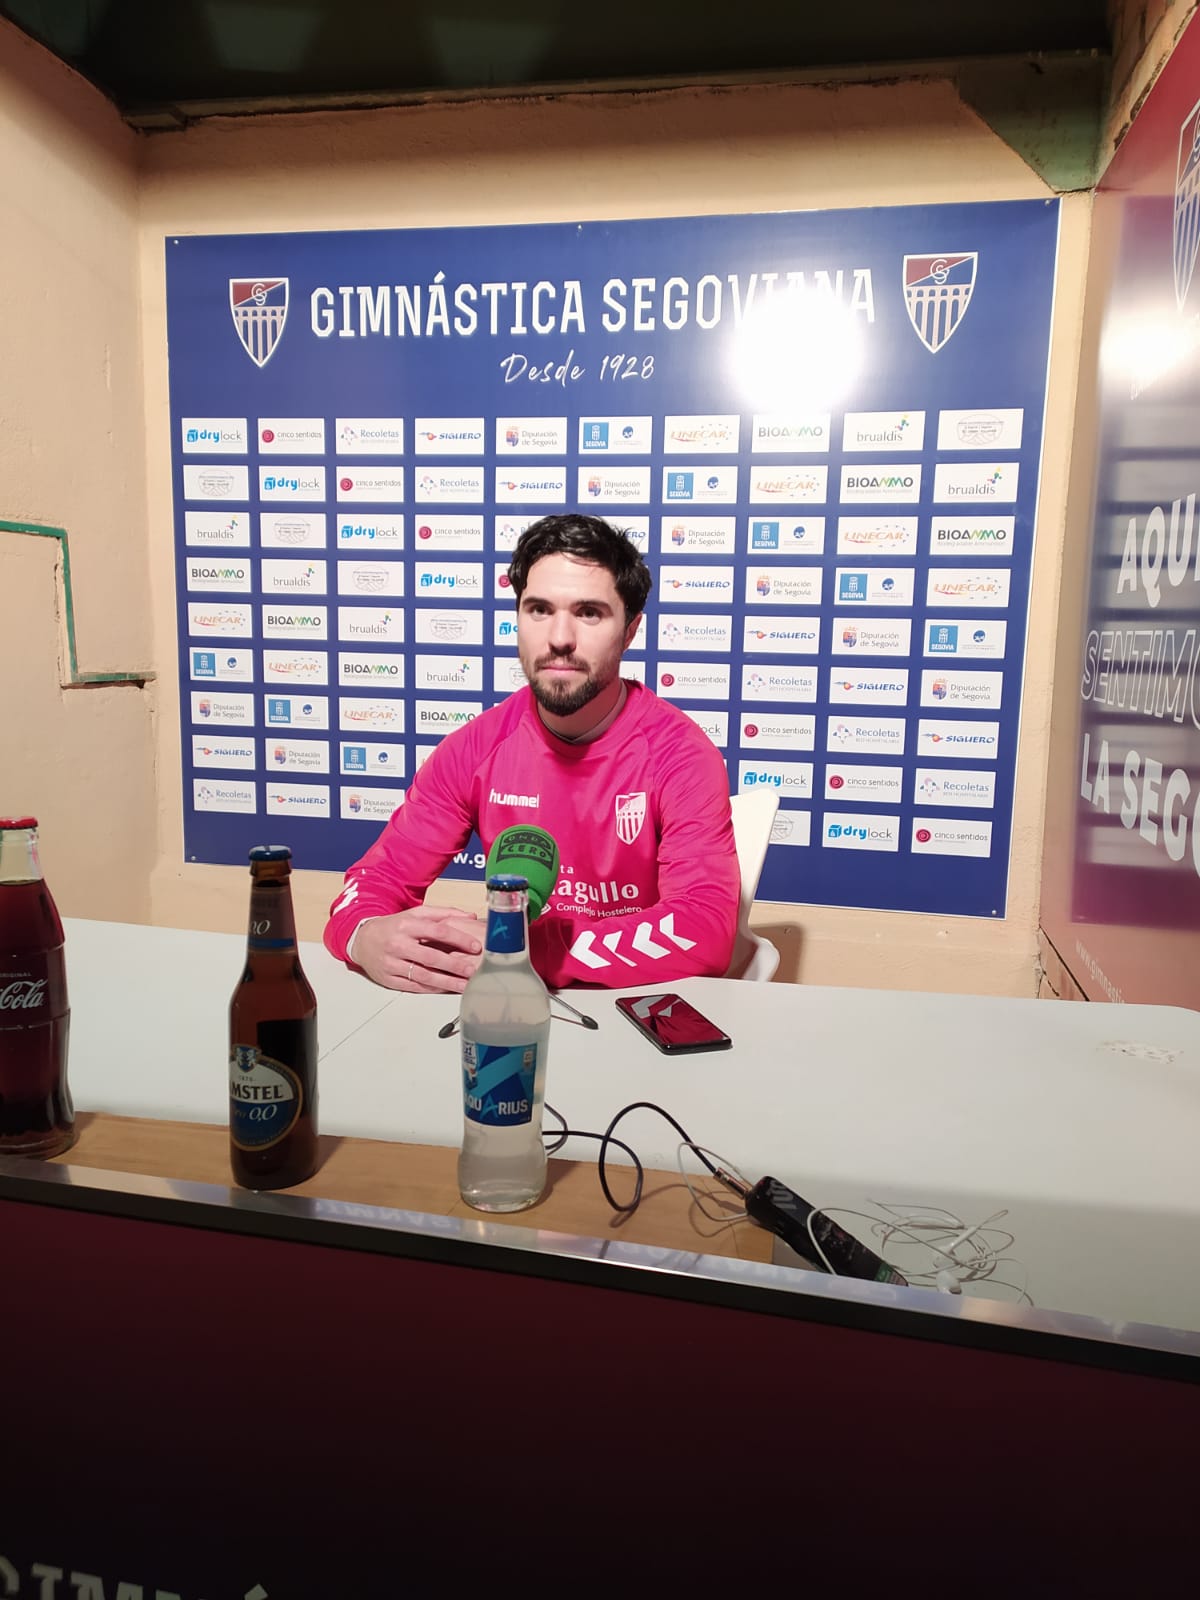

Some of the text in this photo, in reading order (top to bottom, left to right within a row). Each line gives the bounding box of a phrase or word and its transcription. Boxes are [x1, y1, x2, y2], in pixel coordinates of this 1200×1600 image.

[311, 270, 585, 337] GIMNÁSTICA
[500, 349, 655, 387] Desde 1928
[200, 429, 242, 443] drylock
[361, 430, 399, 438] Recoletas
[857, 431, 902, 441] brualdis
[277, 477, 319, 490] drylock
[948, 484, 995, 495] brualdis
[197, 529, 233, 538] brualdis
[355, 525, 397, 539] drylock
[273, 577, 310, 586] brualdis
[434, 574, 477, 587] drylock
[350, 624, 387, 633] brualdis
[684, 627, 726, 635] Recoletas
[427, 673, 465, 682] brualdis
[769, 677, 812, 685] Recoletas
[856, 728, 900, 737] Recoletas
[759, 773, 806, 786] drylock
[1080, 732, 1110, 814] LA
[944, 782, 989, 792] Recoletas
[489, 788, 540, 808] hummel
[844, 826, 892, 839] drylock
[508, 844, 546, 858] CERO
[552, 880, 639, 904] agullo
[556, 902, 642, 917] Complejo Hostelero
[231, 1082, 284, 1100] MSTEL
